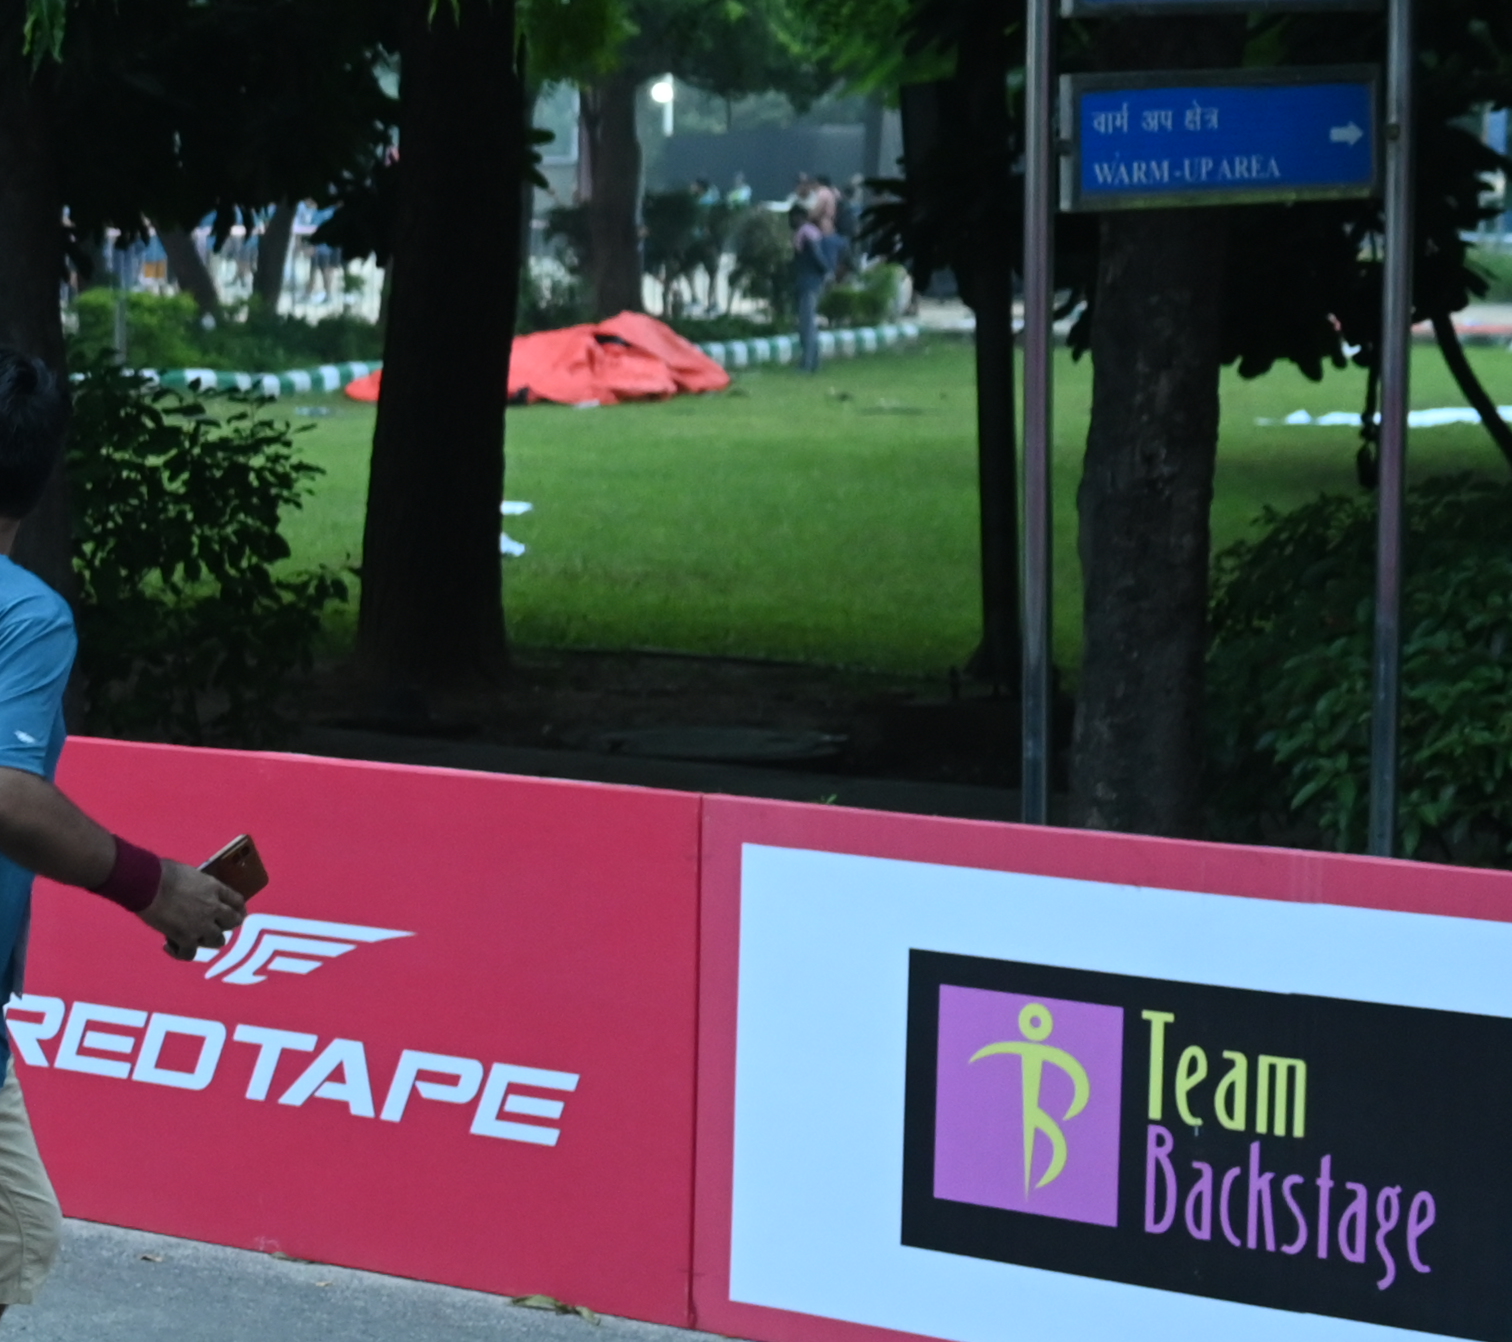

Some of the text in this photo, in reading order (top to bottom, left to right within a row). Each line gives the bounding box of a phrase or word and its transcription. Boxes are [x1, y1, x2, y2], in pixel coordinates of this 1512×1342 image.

[1218, 154, 1281, 180] AREA
[3, 991, 581, 1147] REDTAPE
[1141, 1009, 1307, 1139] Team
[1144, 1124, 1436, 1291] Backstage
